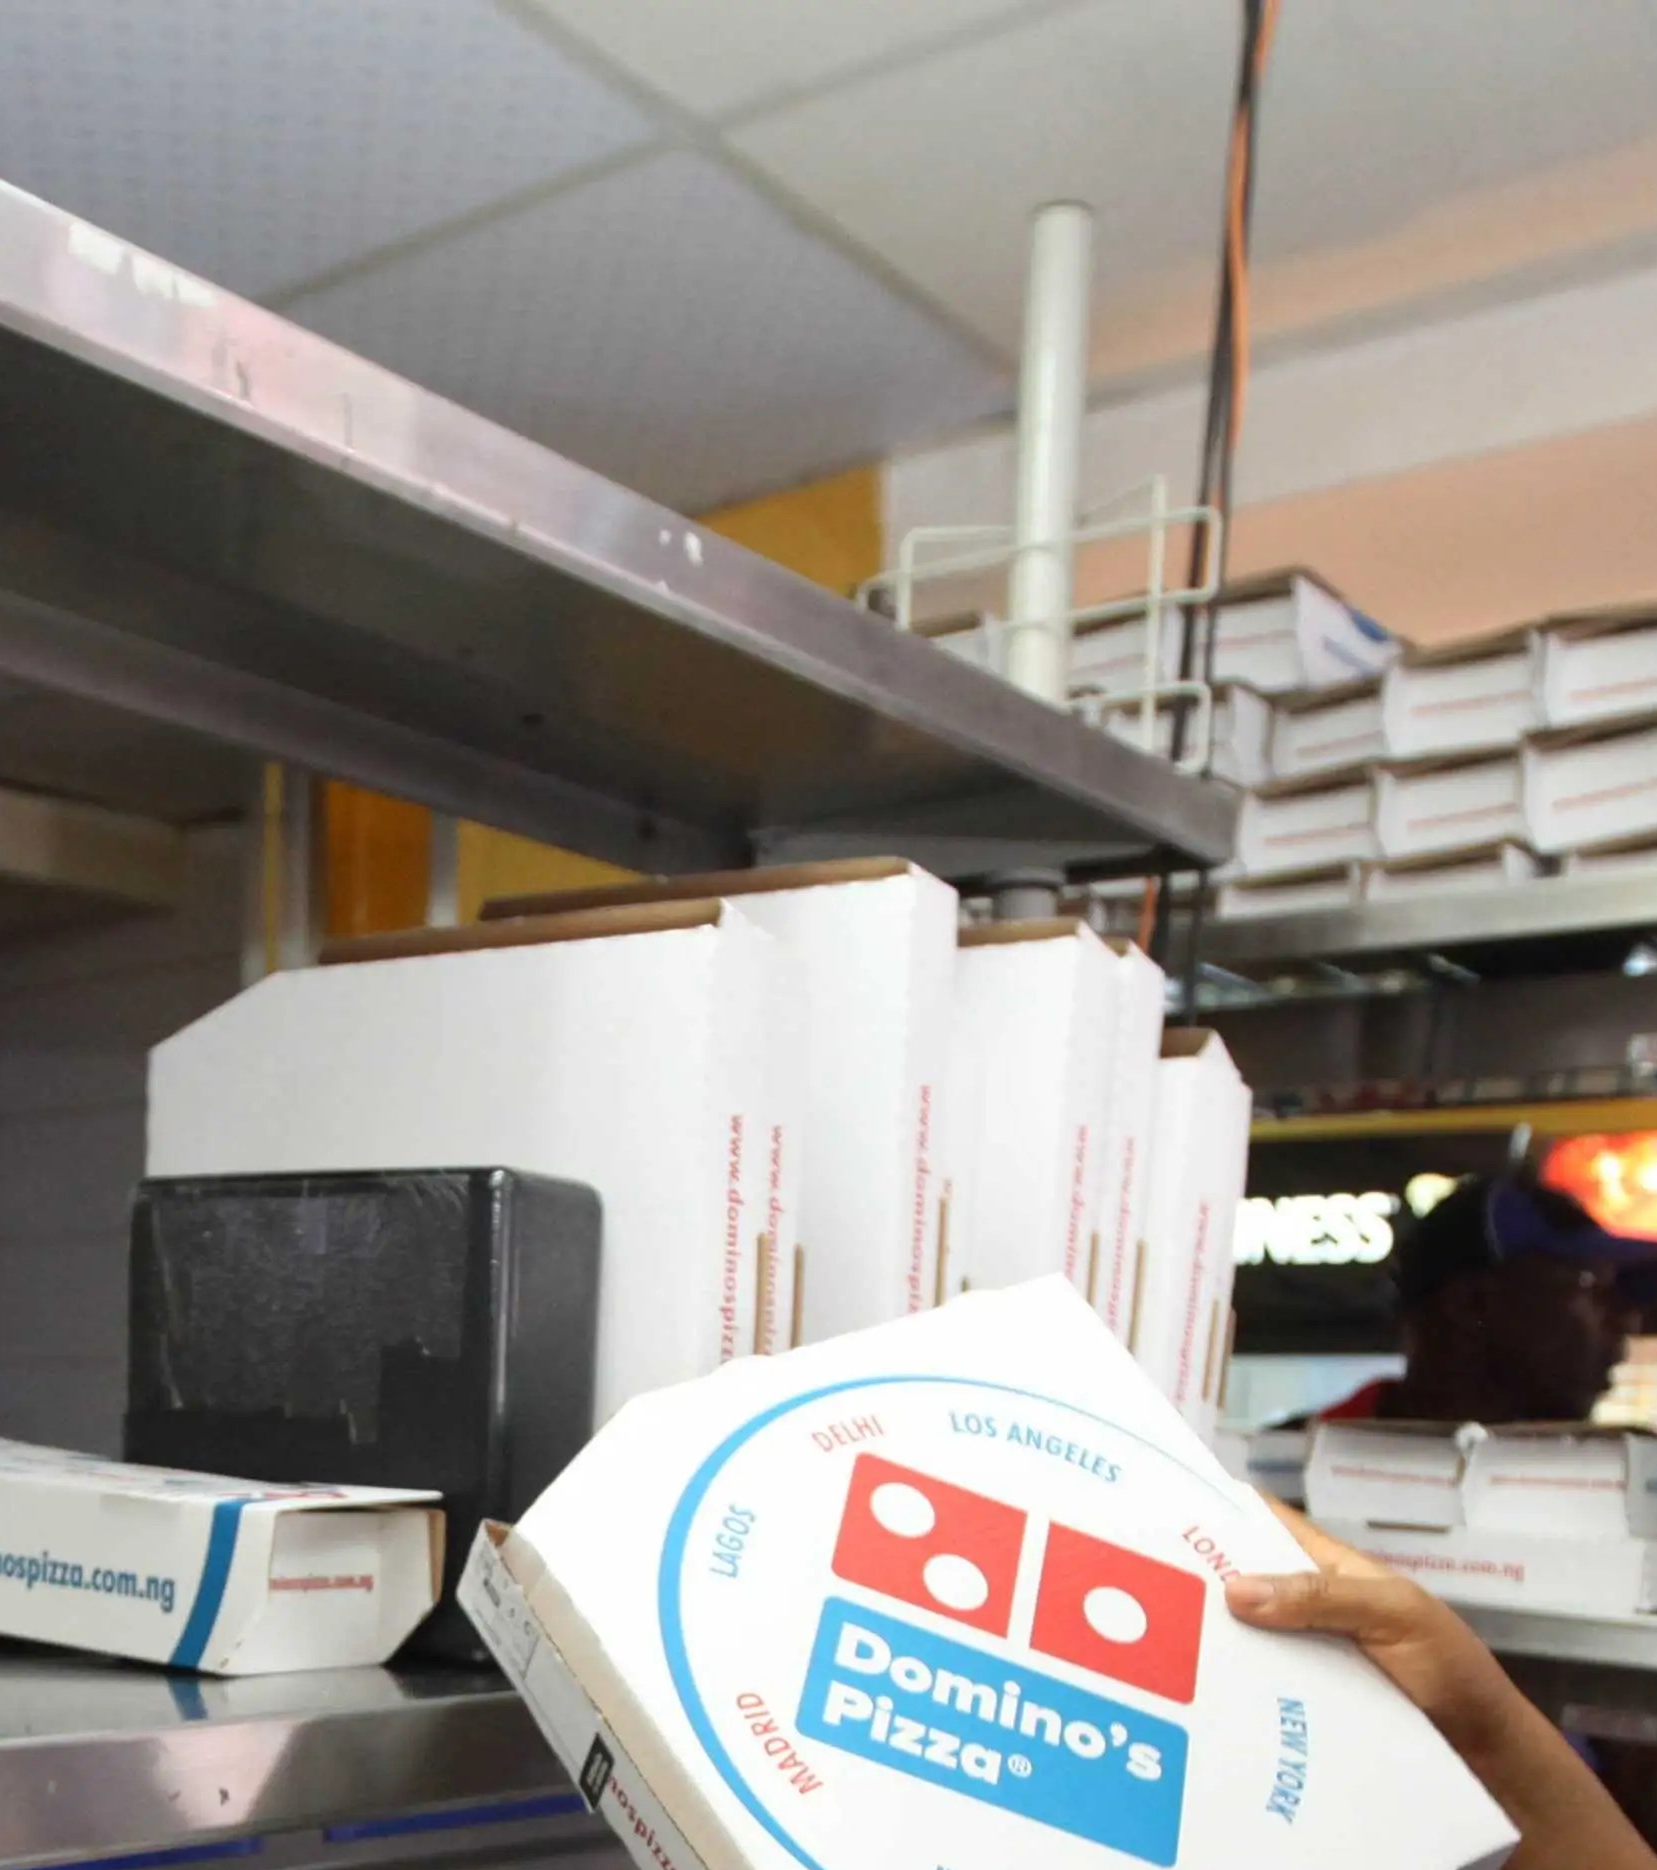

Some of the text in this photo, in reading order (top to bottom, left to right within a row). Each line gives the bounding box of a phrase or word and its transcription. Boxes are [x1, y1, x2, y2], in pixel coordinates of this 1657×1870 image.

[809, 1413, 886, 1454] DELHI
[949, 1408, 1123, 1486] LOS ANGELES
[708, 1501, 758, 1581] LAGOS
[735, 1691, 825, 1797] MADRID
[833, 1619, 1164, 1783] Domino's
[1264, 1695, 1309, 1825] NEW YORK
